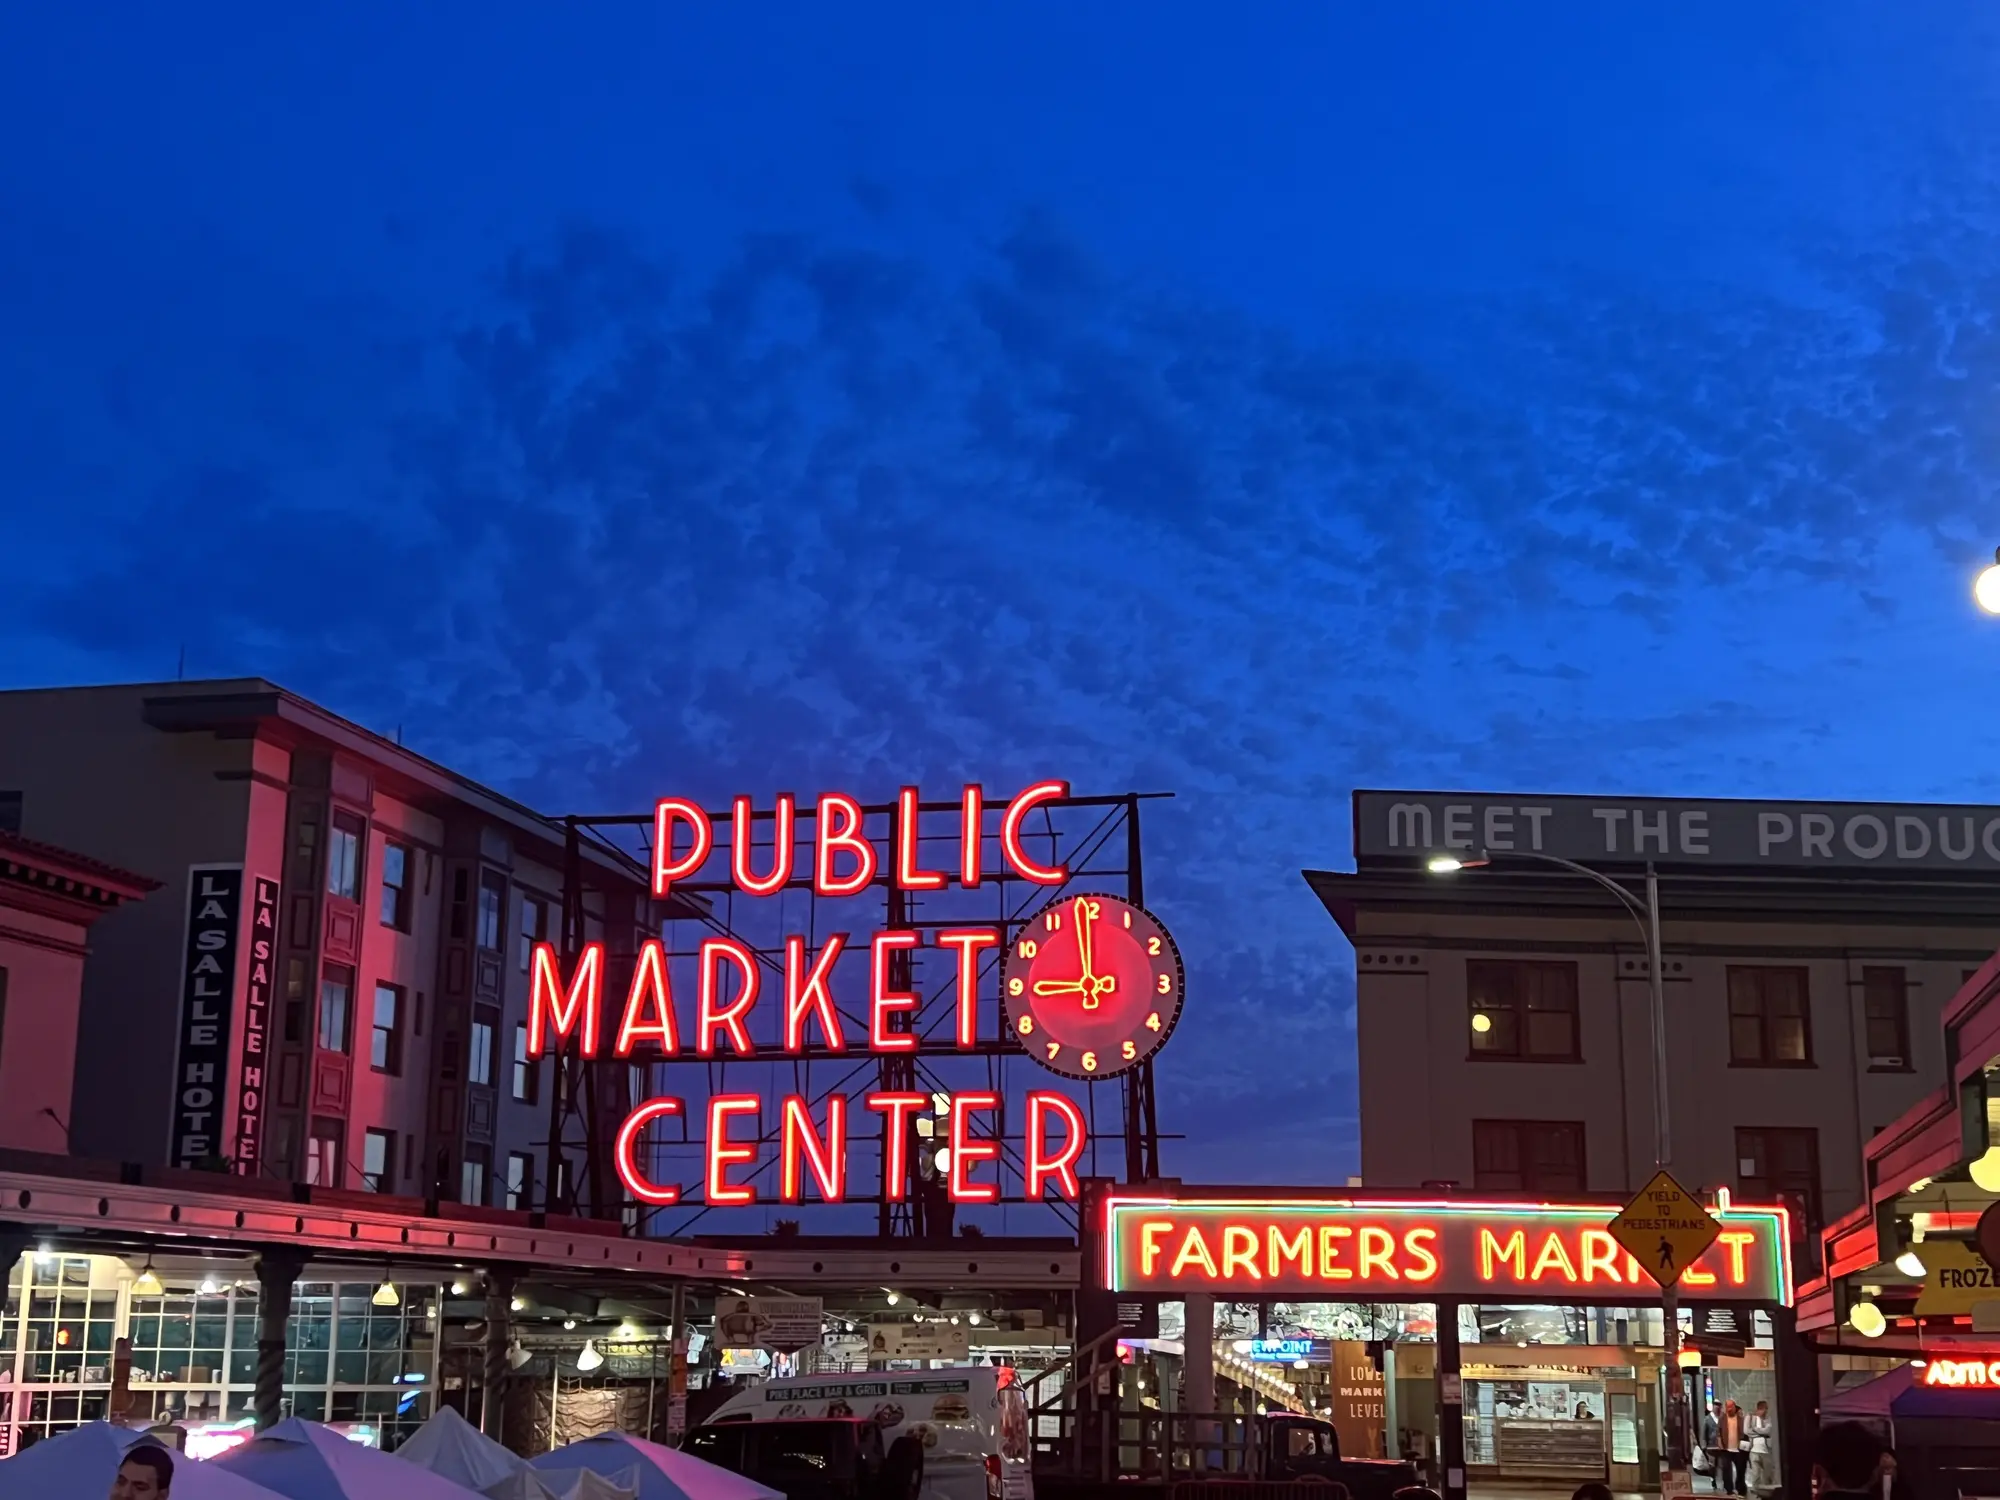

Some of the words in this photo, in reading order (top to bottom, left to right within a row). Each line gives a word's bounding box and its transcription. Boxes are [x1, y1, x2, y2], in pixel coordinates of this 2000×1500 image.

[1388, 803, 1553, 850] MEET
[1593, 807, 1711, 855] THE
[651, 780, 1070, 899] PUBLIC
[196, 877, 229, 919] LA
[256, 883, 273, 928] LA
[1045, 912, 1061, 932] 11
[1123, 911, 1132, 930] 1
[1018, 939, 1037, 959] 10
[1147, 936, 1161, 956] 2
[190, 930, 227, 1046] SALLE
[1008, 977, 1024, 996] 9
[1156, 973, 1171, 994] 3
[246, 940, 270, 1054] SALLE
[525, 927, 1006, 1061] MARKET
[1018, 1014, 1034, 1035] 8
[1145, 1012, 1161, 1032] 4
[1046, 1042, 1060, 1060] 7
[1122, 1040, 1137, 1060] 5
[1081, 1051, 1098, 1072] 6
[614, 1088, 1088, 1203] CENTER
[1646, 1191, 1681, 1202] YIELD
[1656, 1205, 1671, 1216] TO
[1623, 1218, 1706, 1230] PEDESTRIANS
[1140, 1221, 1438, 1282] FARMERS
[1350, 1366, 1386, 1381] LOWE
[769, 1389, 789, 1401] PIKE
[791, 1387, 821, 1400] PLACE
[855, 1383, 884, 1396] GRILL
[1350, 1403, 1387, 1418] LEVEL
